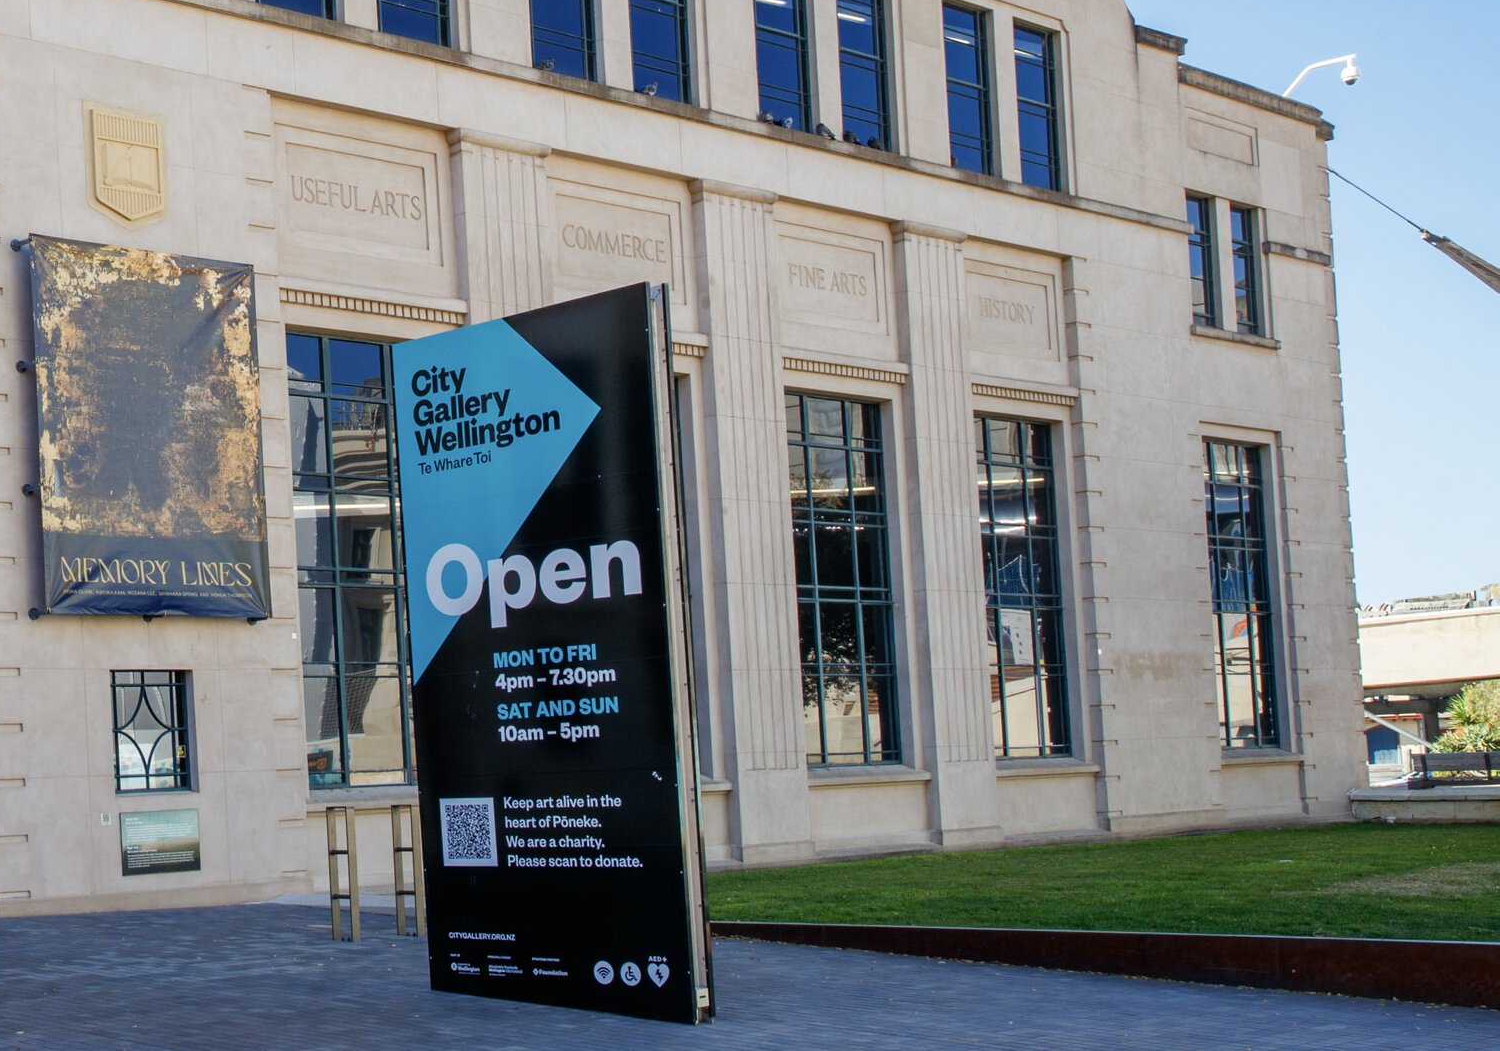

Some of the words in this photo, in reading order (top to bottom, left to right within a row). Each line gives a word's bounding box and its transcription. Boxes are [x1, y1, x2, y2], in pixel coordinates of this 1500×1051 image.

[289, 174, 367, 212] USEFUL
[371, 190, 422, 221] ARTS
[561, 223, 668, 264] COMMERCE
[786, 262, 827, 290] FINE
[829, 270, 868, 297] ARTS
[978, 296, 1036, 325] HISTORY
[411, 365, 466, 397] City
[413, 388, 511, 427] Gallery
[414, 410, 561, 457] Wellington
[418, 462, 432, 475] Te
[433, 456, 473, 473] Whare
[473, 450, 492, 465] Toi
[60, 556, 171, 586] MEMORY
[181, 560, 252, 587] LINES
[425, 539, 643, 629] Open
[493, 649, 534, 668] MON
[537, 647, 564, 664] TO
[567, 643, 597, 662] FRI
[495, 673, 534, 693] 4pm
[549, 667, 616, 687] 7.30pm
[497, 701, 532, 720] SAT
[536, 699, 576, 718] AND
[579, 696, 619, 715] SUN
[498, 725, 544, 742] 10am
[560, 722, 600, 742] 5pm
[503, 796, 534, 811] Keep
[536, 796, 553, 808] art
[555, 795, 584, 808] alive
[586, 794, 598, 807] in
[600, 794, 622, 807] the
[504, 816, 536, 828] heart
[538, 815, 552, 828] of
[552, 815, 602, 828] Pōneke.
[505, 835, 525, 848] We
[527, 837, 546, 848] are
[548, 837, 556, 848] a
[558, 834, 605, 850] charity.
[507, 854, 546, 867] Please
[548, 856, 578, 867] scan
[579, 855, 592, 867] to
[594, 854, 643, 868] donate.
[448, 932, 516, 941] CITYGALLERY.ORG.NZ
[538, 968, 568, 977] Foundation
